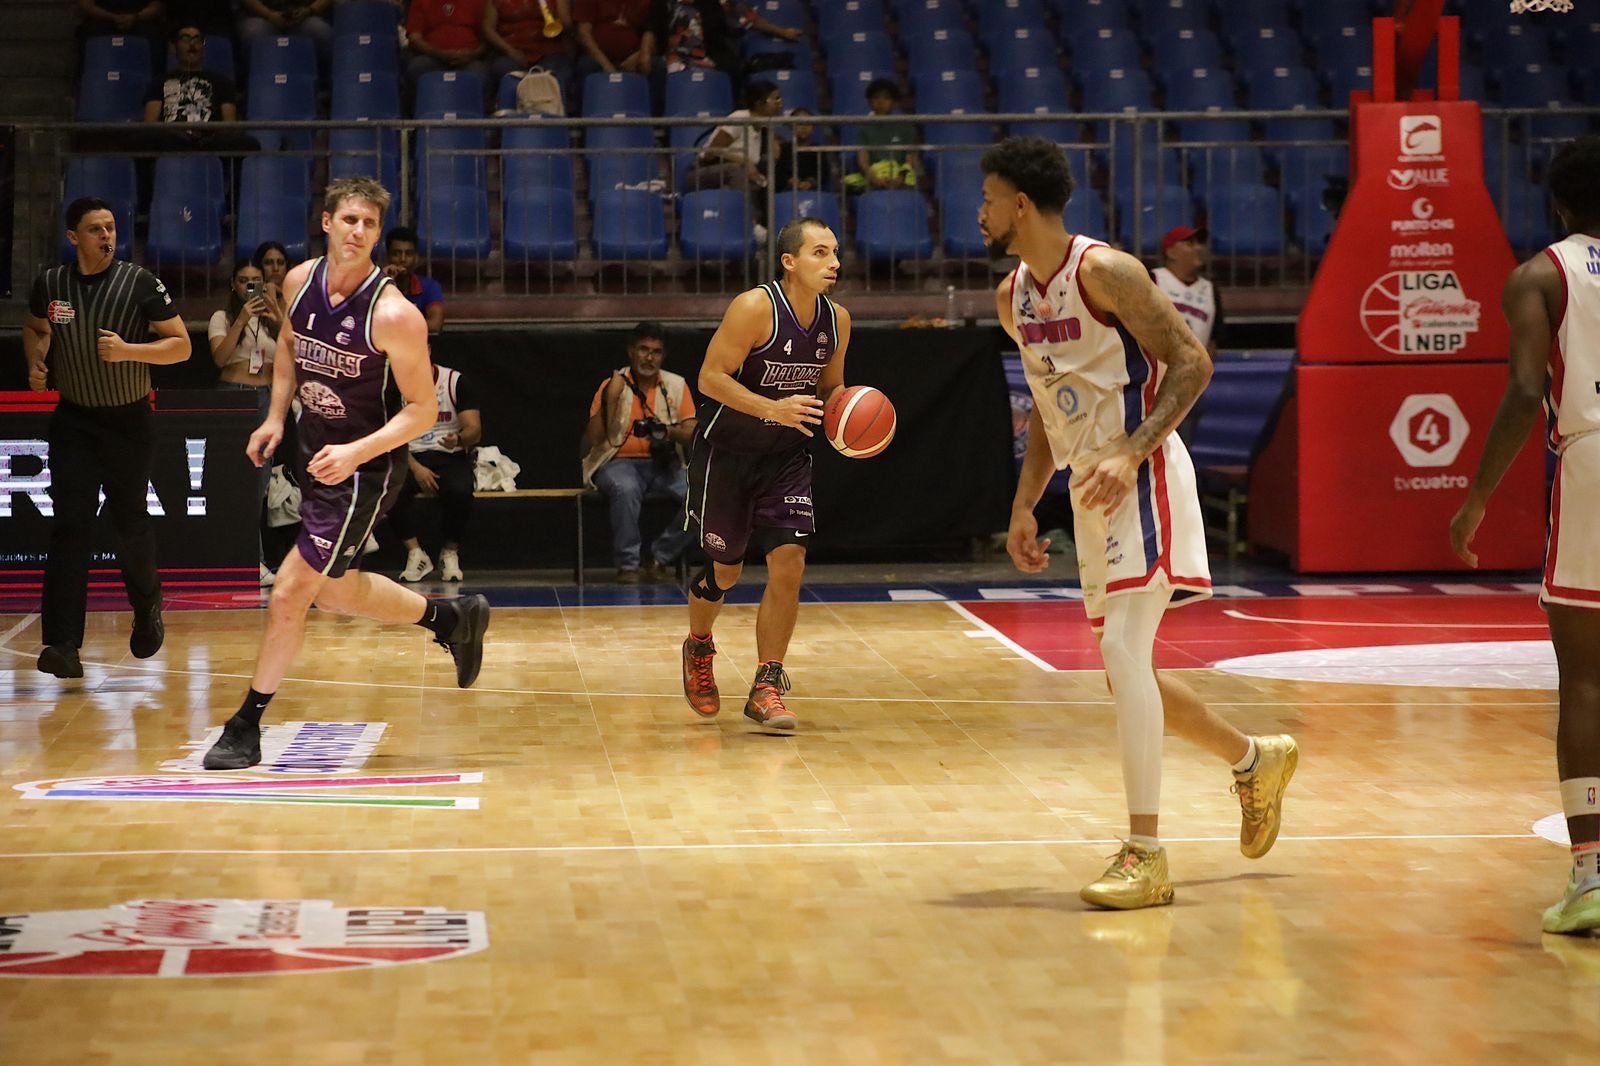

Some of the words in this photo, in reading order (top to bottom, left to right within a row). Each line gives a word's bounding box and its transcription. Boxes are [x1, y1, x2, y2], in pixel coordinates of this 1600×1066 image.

[1389, 168, 1450, 188] VALUE
[1390, 242, 1455, 258] molten
[1403, 273, 1458, 290] LIGA
[306, 313, 317, 331] 1
[783, 339, 793, 356] 4
[1404, 334, 1462, 352] LNBP
[1416, 413, 1442, 446] 4
[1394, 474, 1469, 490] tvcuatro
